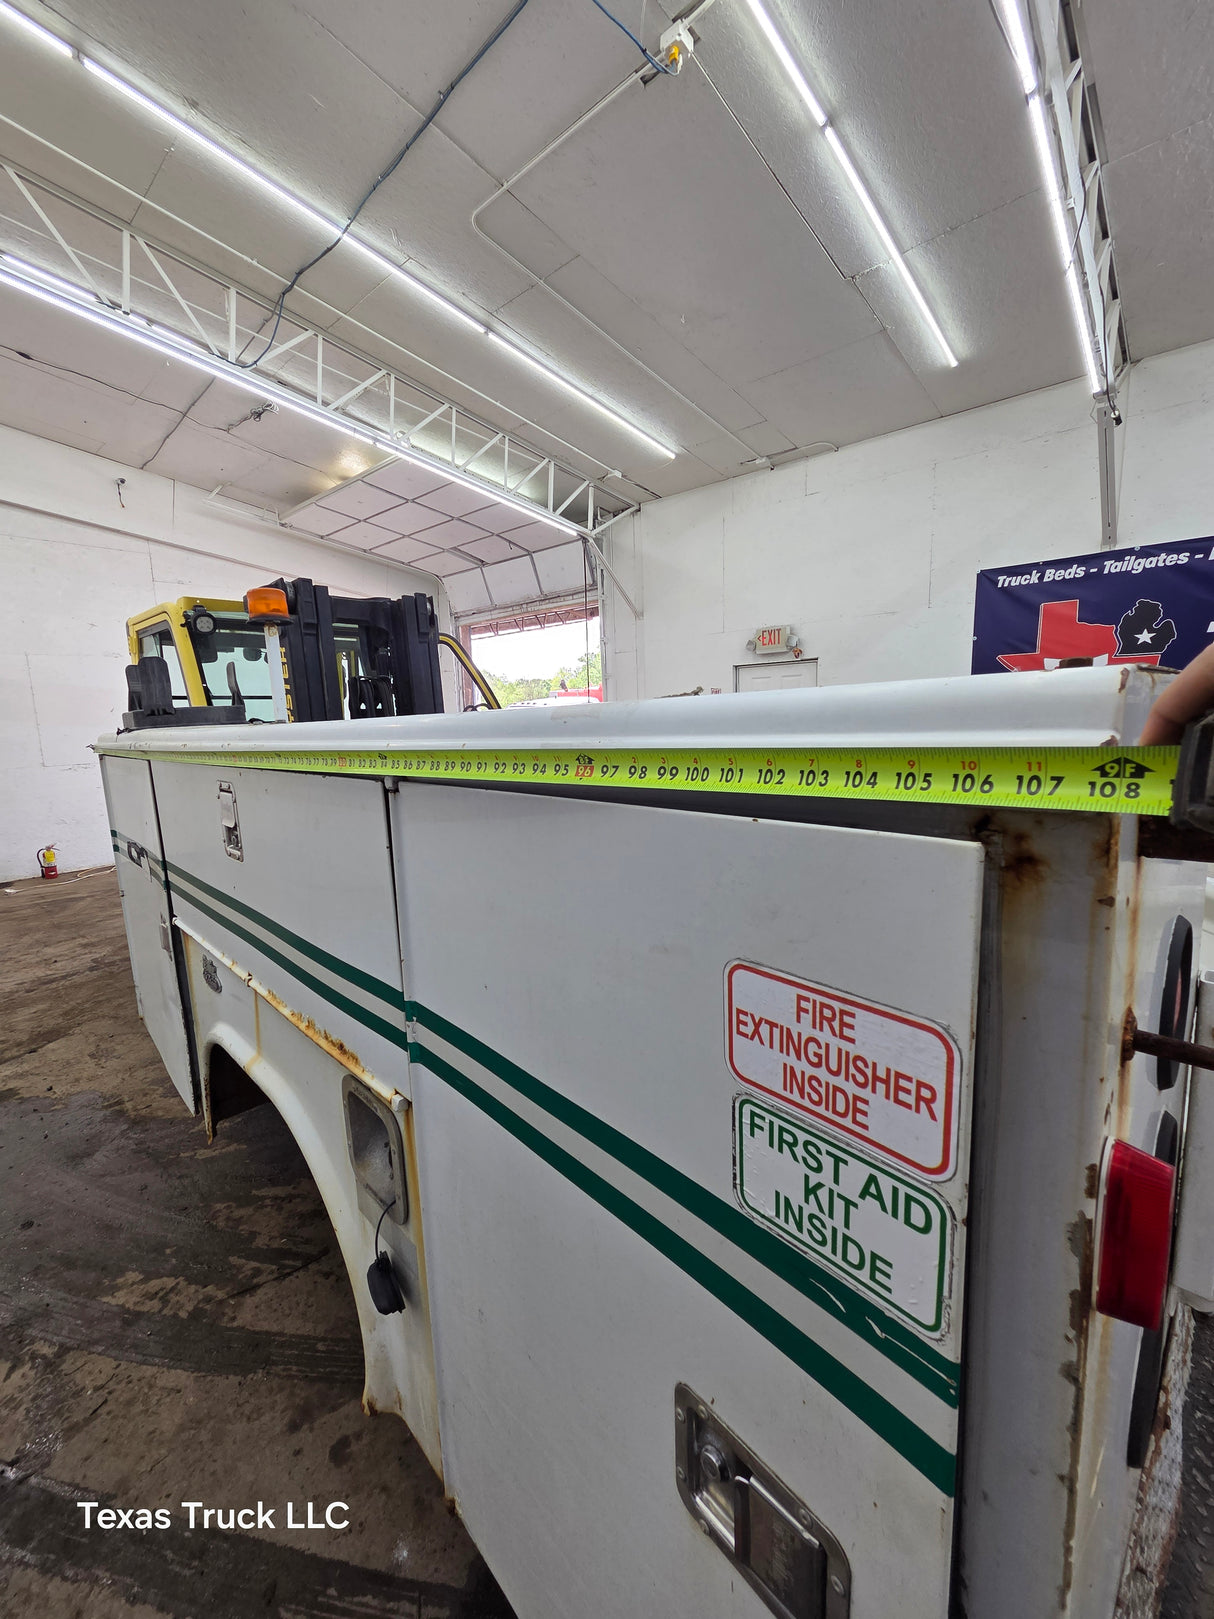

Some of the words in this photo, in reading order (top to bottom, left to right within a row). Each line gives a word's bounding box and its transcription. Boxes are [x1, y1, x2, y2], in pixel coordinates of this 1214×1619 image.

[997, 570, 1040, 588] Truck
[1043, 564, 1086, 583] Beds
[1103, 552, 1190, 575] Tailgates
[762, 628, 781, 646] EXIT
[391, 760, 400, 769] 85
[403, 760, 413, 770] 86
[416, 760, 426, 770] 87
[429, 760, 440, 771] 88
[444, 761, 456, 771] 89
[460, 761, 472, 772] 90
[476, 762, 487, 773] 91
[493, 762, 507, 774] 92
[512, 762, 526, 775] 93
[532, 763, 547, 775] 94
[554, 763, 569, 776] 95
[578, 766, 591, 777] 96
[601, 764, 619, 778] 97
[628, 765, 648, 779] 98
[657, 766, 679, 780] 99
[685, 766, 710, 782] 100
[719, 767, 744, 783] 101
[757, 768, 786, 785] 102
[798, 769, 829, 787] 103
[843, 770, 878, 788] 104
[895, 771, 932, 791] 105
[952, 773, 994, 794] 106
[1016, 774, 1065, 796] 107
[1088, 781, 1141, 799] 108
[632, 756, 637, 764] 2
[728, 758, 734, 766] 5
[766, 758, 773, 767] 6
[808, 758, 815, 767] 7
[855, 759, 863, 769] 8
[907, 760, 916, 769] 9
[960, 761, 977, 770] 10
[1026, 761, 1042, 772] 11
[1105, 763, 1136, 778] 9F
[795, 993, 856, 1045] FIRE
[735, 1007, 938, 1122] EXTINGUISHER
[782, 1062, 870, 1131] INSIDE
[749, 1109, 849, 1186] FIRST
[858, 1173, 933, 1235] AID
[803, 1173, 861, 1232] KIT
[774, 1190, 893, 1295] INSIDE
